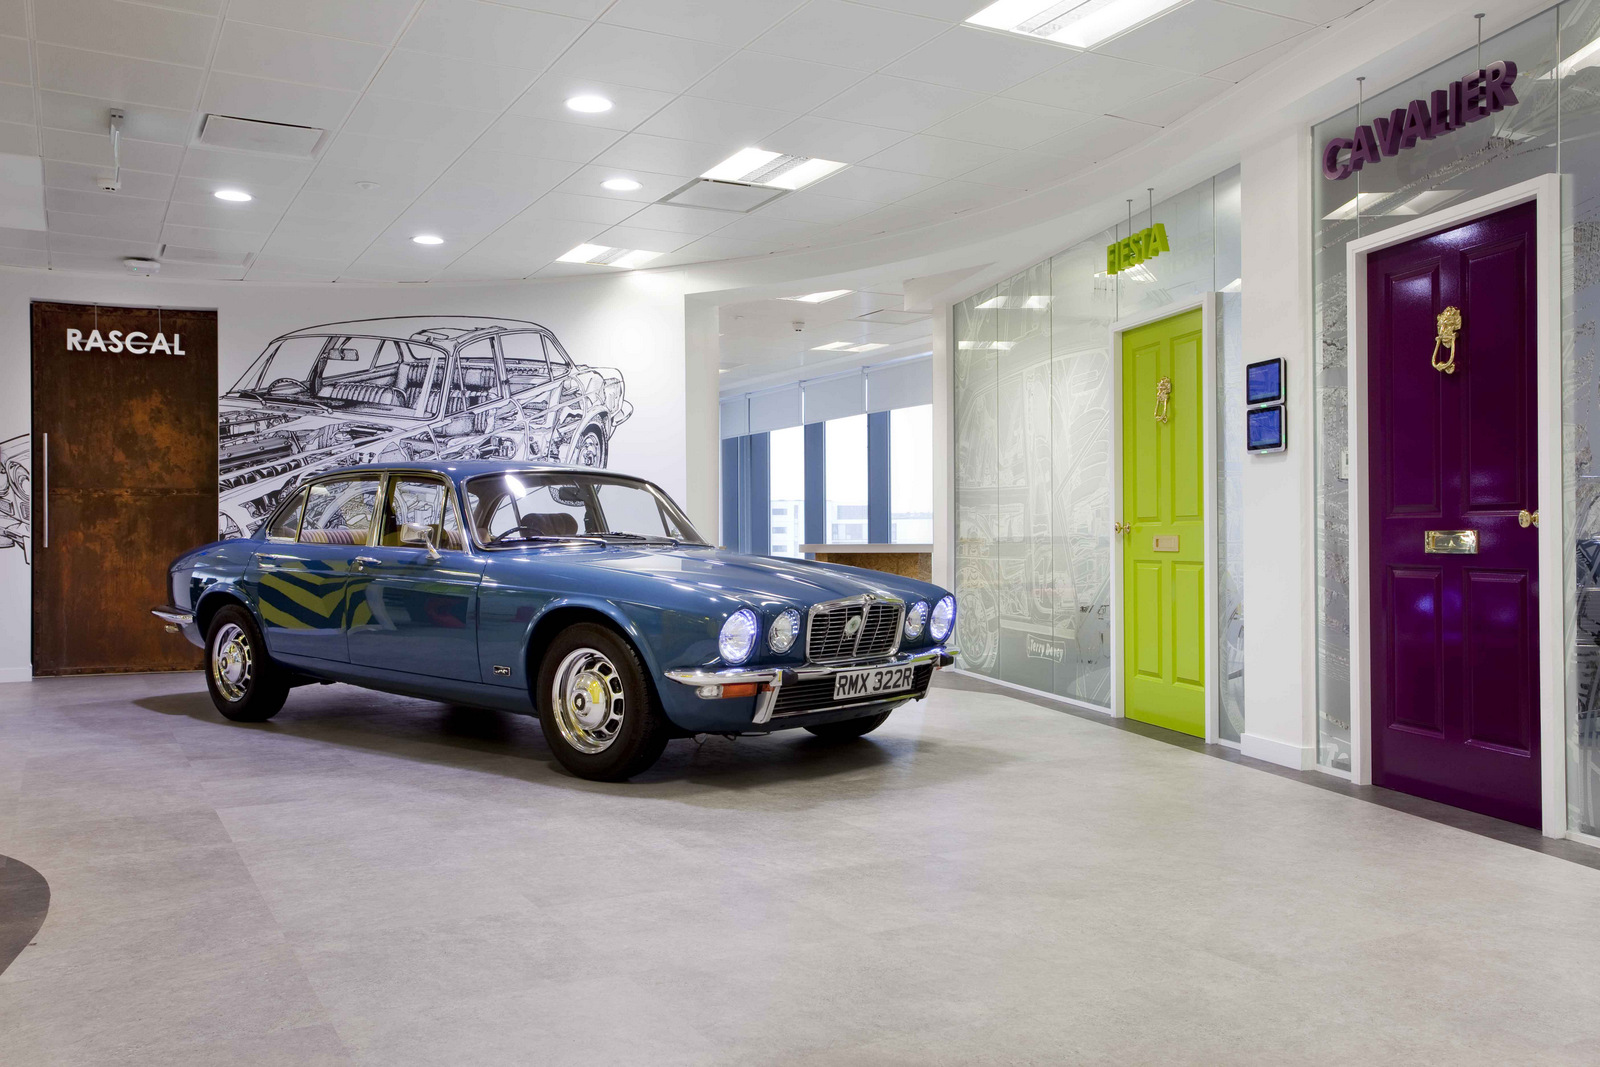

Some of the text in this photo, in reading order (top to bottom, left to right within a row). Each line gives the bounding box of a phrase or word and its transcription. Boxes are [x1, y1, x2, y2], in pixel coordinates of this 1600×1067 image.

[1322, 60, 1519, 180] CAVALIER
[1107, 223, 1170, 275] FIESTA
[66, 328, 186, 356] RASCAL
[836, 667, 912, 697] RMX 322R
